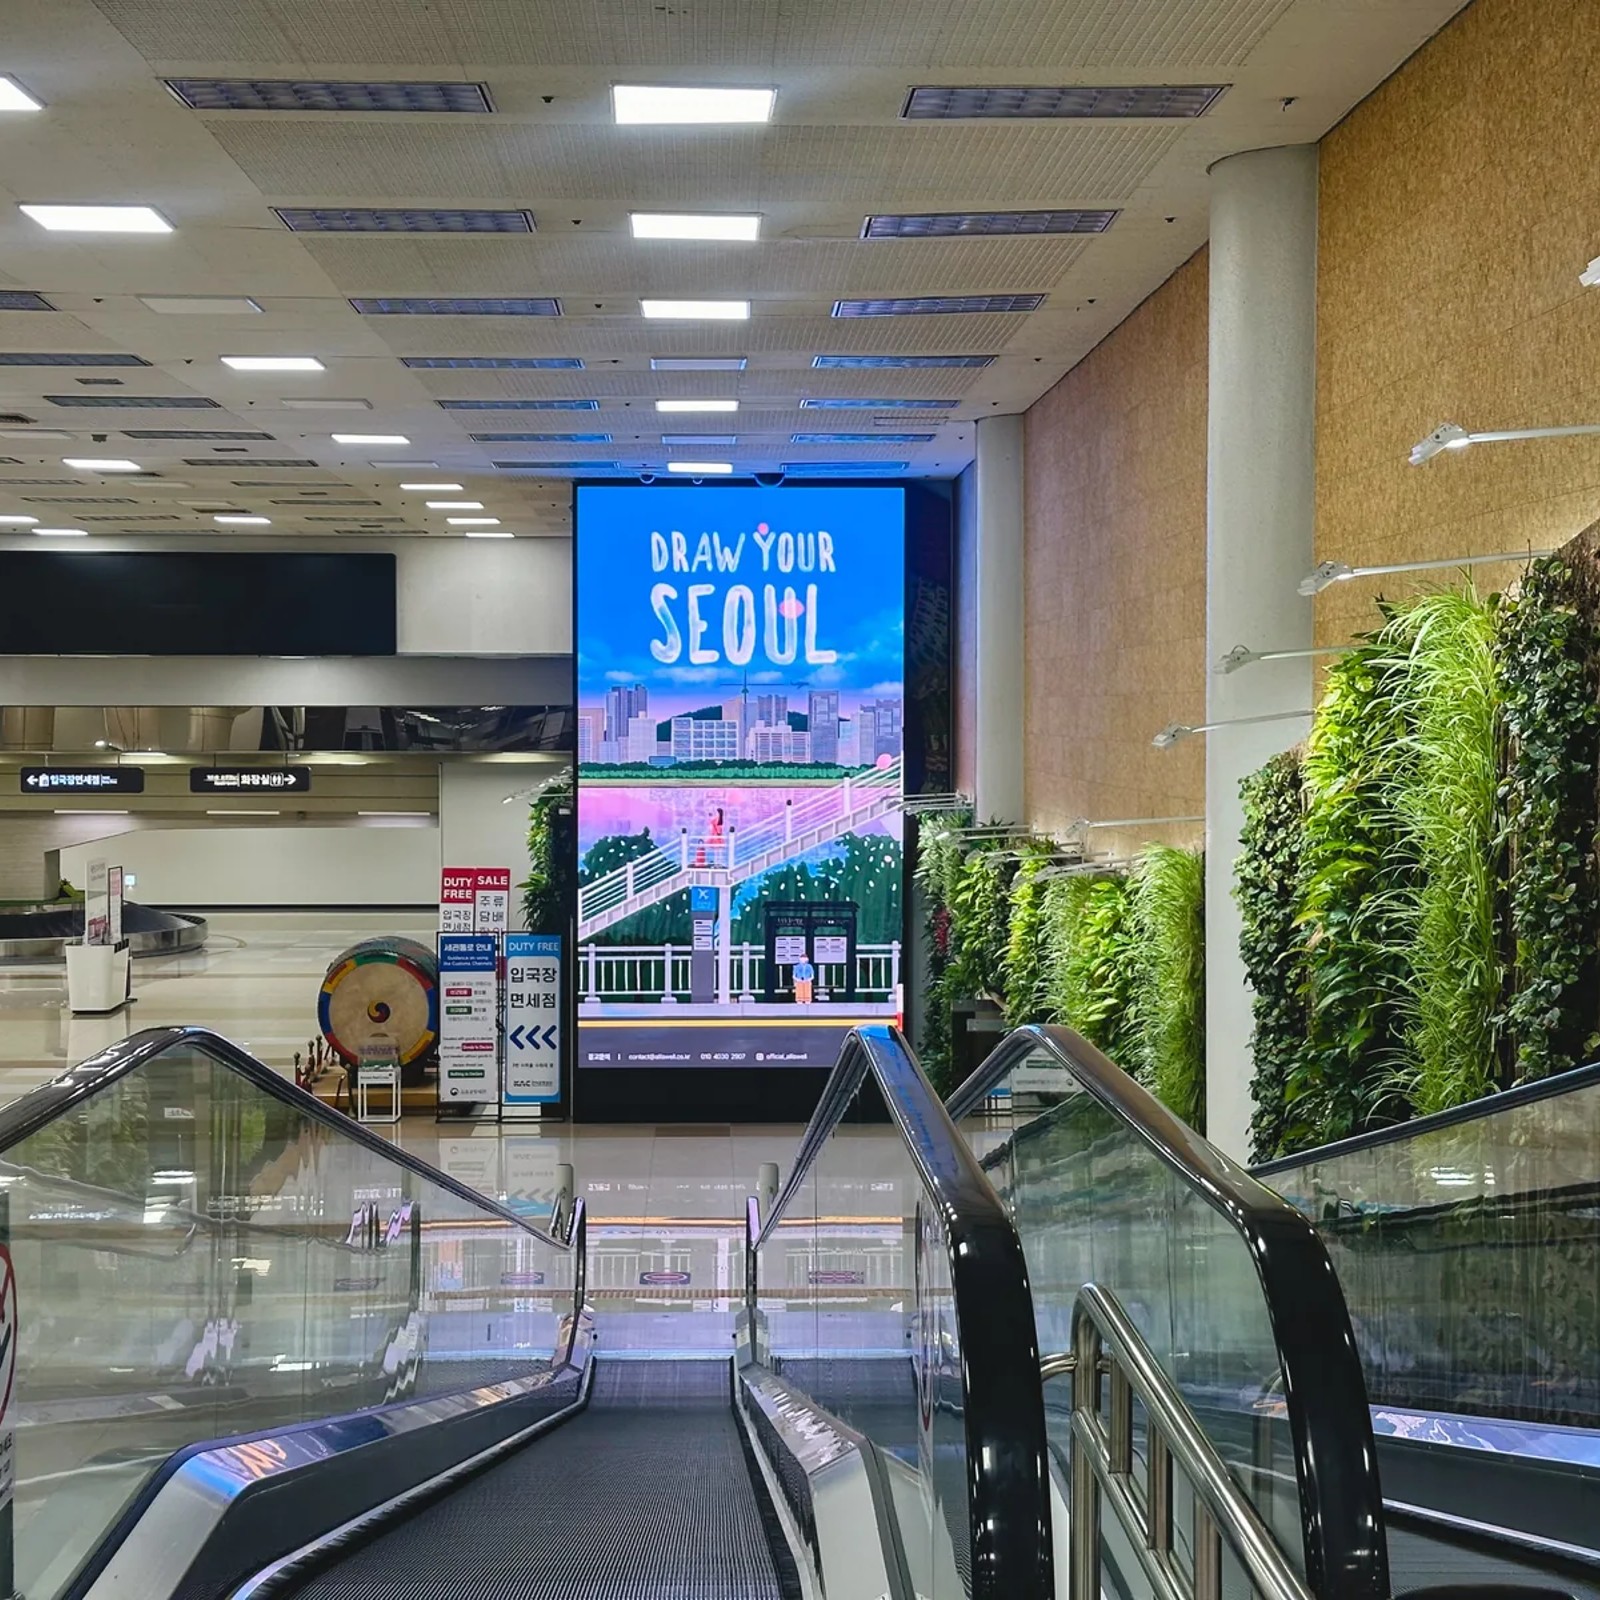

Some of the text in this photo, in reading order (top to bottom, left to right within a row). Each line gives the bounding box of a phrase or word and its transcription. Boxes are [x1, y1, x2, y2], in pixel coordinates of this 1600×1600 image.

[650, 531, 837, 573] DRAW YOUR
[650, 583, 838, 666] SEOUL
[50, 774, 100, 785] 입국장면세점
[241, 774, 270, 785] 화장실
[444, 877, 472, 887] DUTY
[477, 875, 508, 885] SALE
[443, 889, 472, 899] FREE
[442, 909, 471, 920] 입국장
[508, 942, 559, 952] DUTY FREE
[510, 967, 557, 984] 입국장
[510, 992, 556, 1009] 면세점
